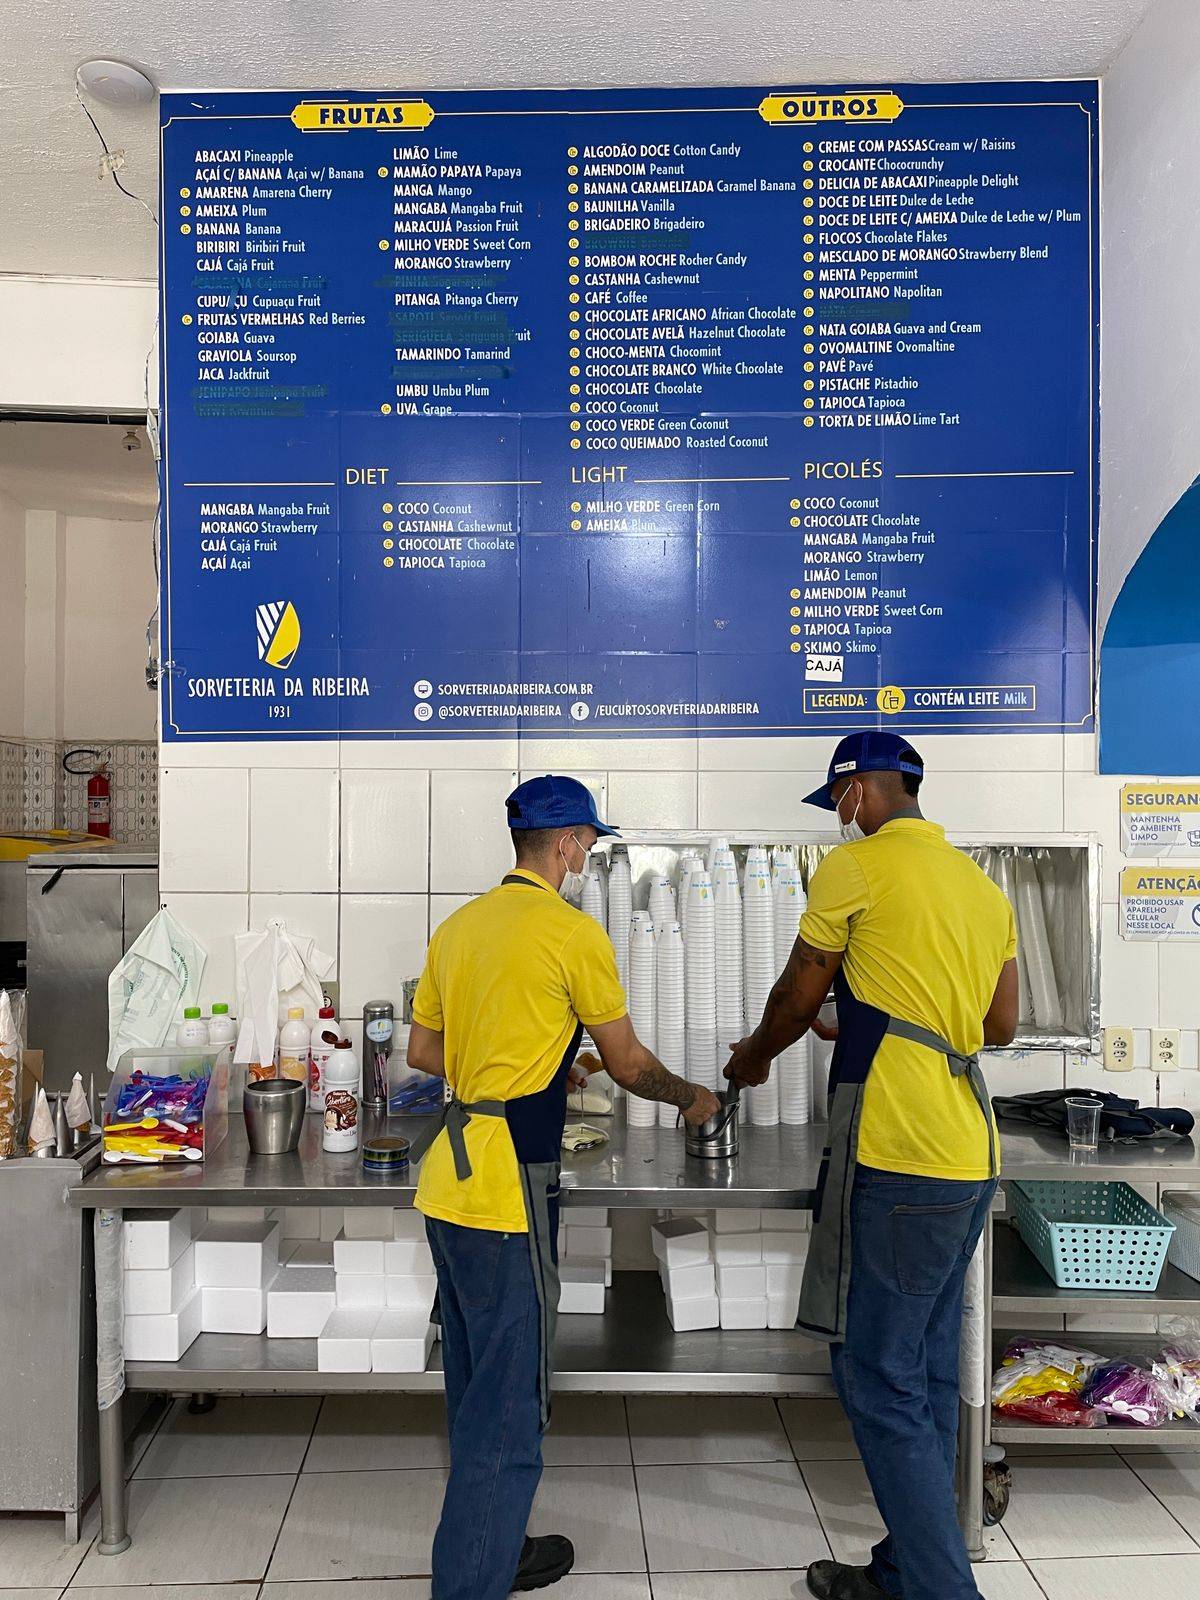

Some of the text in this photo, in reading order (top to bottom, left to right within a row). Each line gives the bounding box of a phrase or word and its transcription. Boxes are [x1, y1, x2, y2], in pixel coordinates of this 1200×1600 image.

[782, 98, 878, 118] OUTROS
[320, 107, 404, 125] FRUTAS
[584, 143, 741, 158] ALGODÃO DOCE Cotton Candy
[819, 141, 855, 153] CREME
[859, 140, 884, 152] COM
[963, 138, 978, 152] w/
[982, 138, 1015, 150] Raisins
[195, 149, 293, 163] ABACAXI Pineapple
[394, 146, 457, 160] LIMÃO Lime
[196, 165, 363, 182] AÇAÍ C/ BANANA Açai w/ Banana
[394, 164, 521, 179] MAMÃO PAPAYA Papaya
[196, 185, 332, 199] AMARENA Amarena Cherry
[584, 179, 795, 194] BANANA CARAMELIZADA Caramel Banana
[395, 217, 518, 233] MARACUJÁ Passion Fruit
[585, 217, 704, 231] BRIGADEIRO Brigadeiro
[819, 209, 1080, 227] DOCE DE LEITE C/ AMEIXA Dulce de Leche w/ Plum
[395, 238, 530, 251] MILHO VERDE Sweet Corn
[395, 256, 511, 270] MORANGO Strawberry
[585, 272, 699, 285] CASTANHA Cashewnut
[585, 289, 647, 303] CAFÉ Coffee
[820, 285, 942, 299] NAPOLITANO Napolitan
[396, 347, 510, 360] TAMARINDO Tamarind
[586, 344, 721, 358] CHOCO-MENTA Chocomint
[819, 340, 954, 354] OVOMALTINE Ovomaltine
[198, 350, 296, 363] GRAVIOLA Soursop
[586, 361, 783, 377] CHOCOLATE BRANCO White Chocolate
[820, 357, 873, 372] PAVÊ Pavé
[198, 367, 269, 380] JACA Jackfruit
[397, 384, 489, 396] UMBU Umbu Plum
[820, 377, 918, 390] PISTACHE Pistachio
[819, 395, 905, 410] TAPIOCA Tapioca
[572, 467, 627, 482] LIGHT
[805, 459, 882, 479] PICOLÉS
[347, 469, 389, 484] DIET
[201, 503, 330, 517] MANGABA Mangaba Fruit
[398, 503, 471, 514] COCO Coconut
[804, 497, 879, 509] COCO Coconut
[399, 520, 512, 532] CASTANHA Cashewnut
[804, 513, 920, 527] CHOCOLATE Chocolate
[201, 521, 318, 535] MORANGO Strawberry
[201, 536, 277, 553] CAJÁ Cajá Fruit
[399, 538, 514, 550] CHOCOLATE Chocolate
[804, 531, 935, 546] MANGABA Mangaba Fruit
[202, 554, 250, 571] AÇAÍ Açai
[399, 556, 485, 570] TAPIOCA Tapioca
[804, 550, 924, 563] MORANGO Strawberry
[805, 568, 877, 581] LIMÃO Lemon
[804, 587, 906, 599] AMENDOIM Peanut
[804, 604, 942, 617] MILHO VERDE Sweet Corn
[804, 622, 891, 636] TAPIOCA Tapioca
[804, 640, 877, 653] SKIMO Skimo
[806, 659, 842, 672] CAJÁ
[188, 678, 369, 697] SORVETERIA DA RIBEIRA
[438, 684, 593, 695] SORVETERIADARIBEIRA.COM.BR
[812, 694, 867, 707] LEGENDA:
[914, 689, 1027, 705] CONTÉM LEITE Milk
[270, 706, 289, 717] 1931
[439, 705, 561, 719] @SORVETERIADARIBEIRA
[595, 702, 759, 718] /EUCURTOSORVETERIADARIBEIRA
[1126, 793, 1200, 806] SEGURAN
[1130, 815, 1181, 823] MANTENHA
[1130, 824, 1183, 832] O AMBIENTE
[1130, 833, 1158, 841] LIMPO
[1150, 922, 1175, 930] LOCAL
